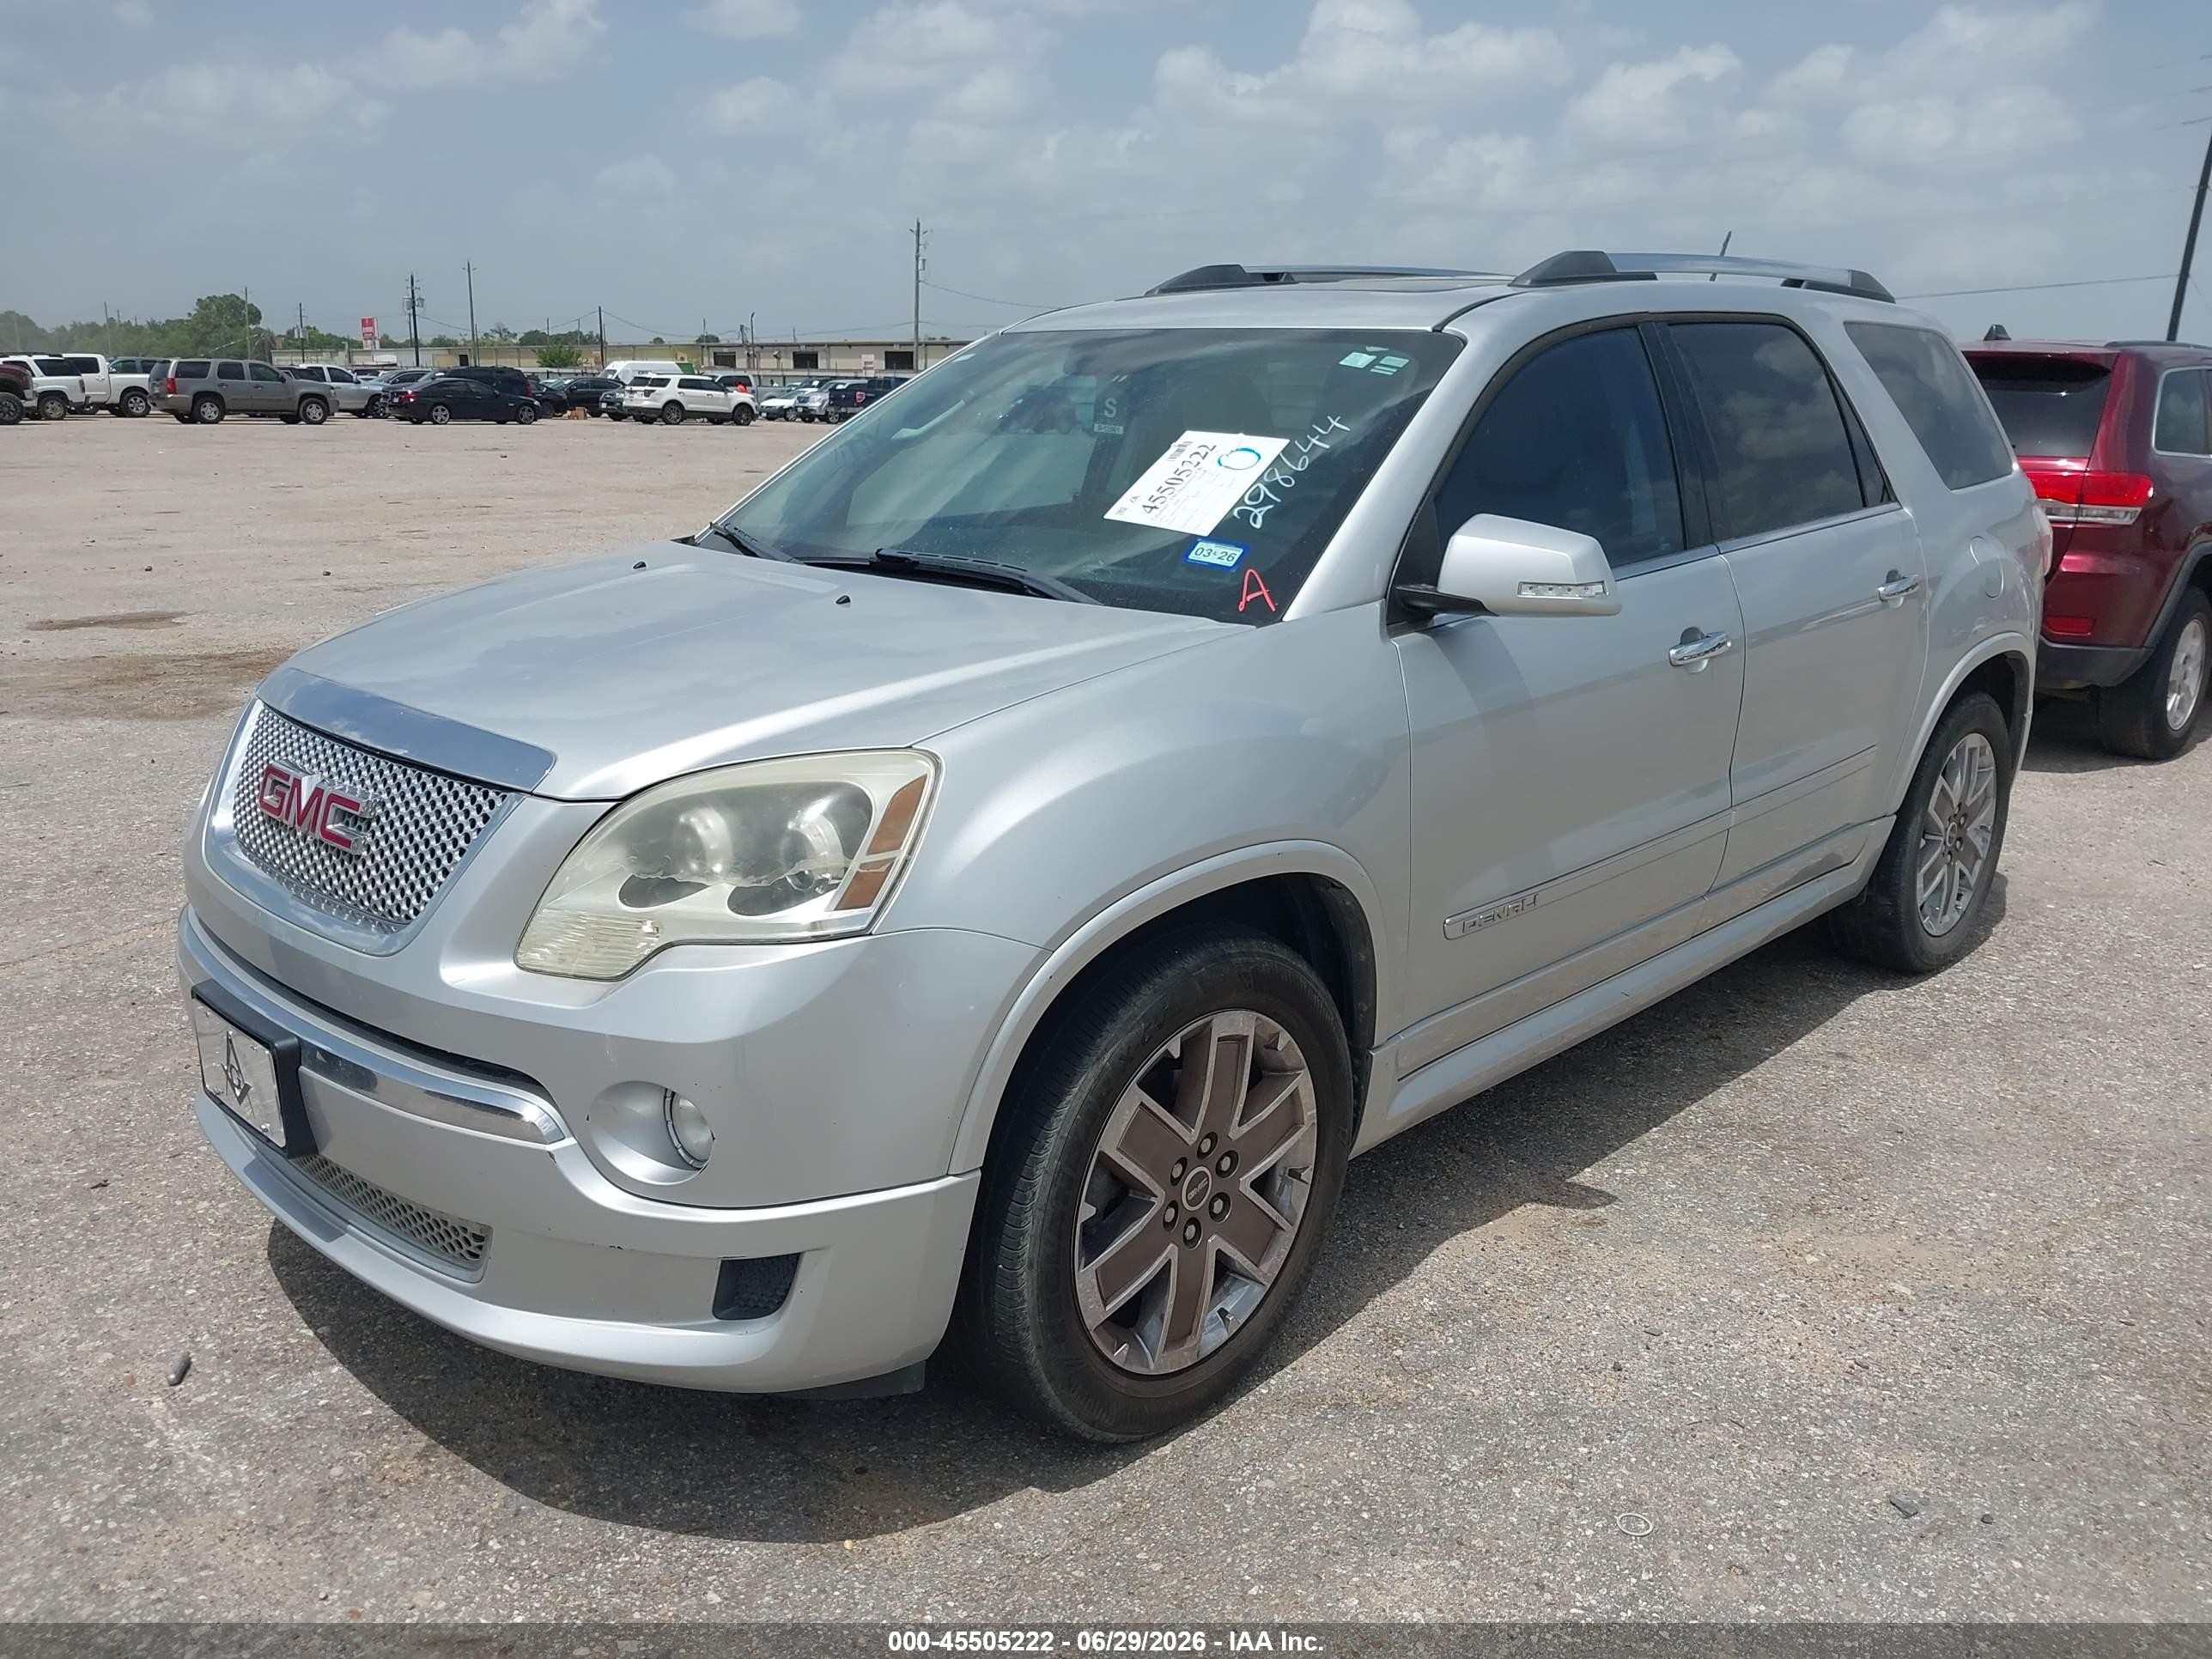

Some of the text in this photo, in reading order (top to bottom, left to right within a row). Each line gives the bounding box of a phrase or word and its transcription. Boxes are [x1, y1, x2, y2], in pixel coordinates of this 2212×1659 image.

[1103, 398, 1118, 418] S
[1142, 444, 1217, 514] 45505222
[1233, 415, 1351, 530] 298644
[1194, 546, 1237, 562] 03 26
[1237, 568, 1277, 612] A
[258, 760, 373, 853] GMC
[1461, 893, 1540, 933] DENALI
[1187, 1176, 1209, 1201] GMC
